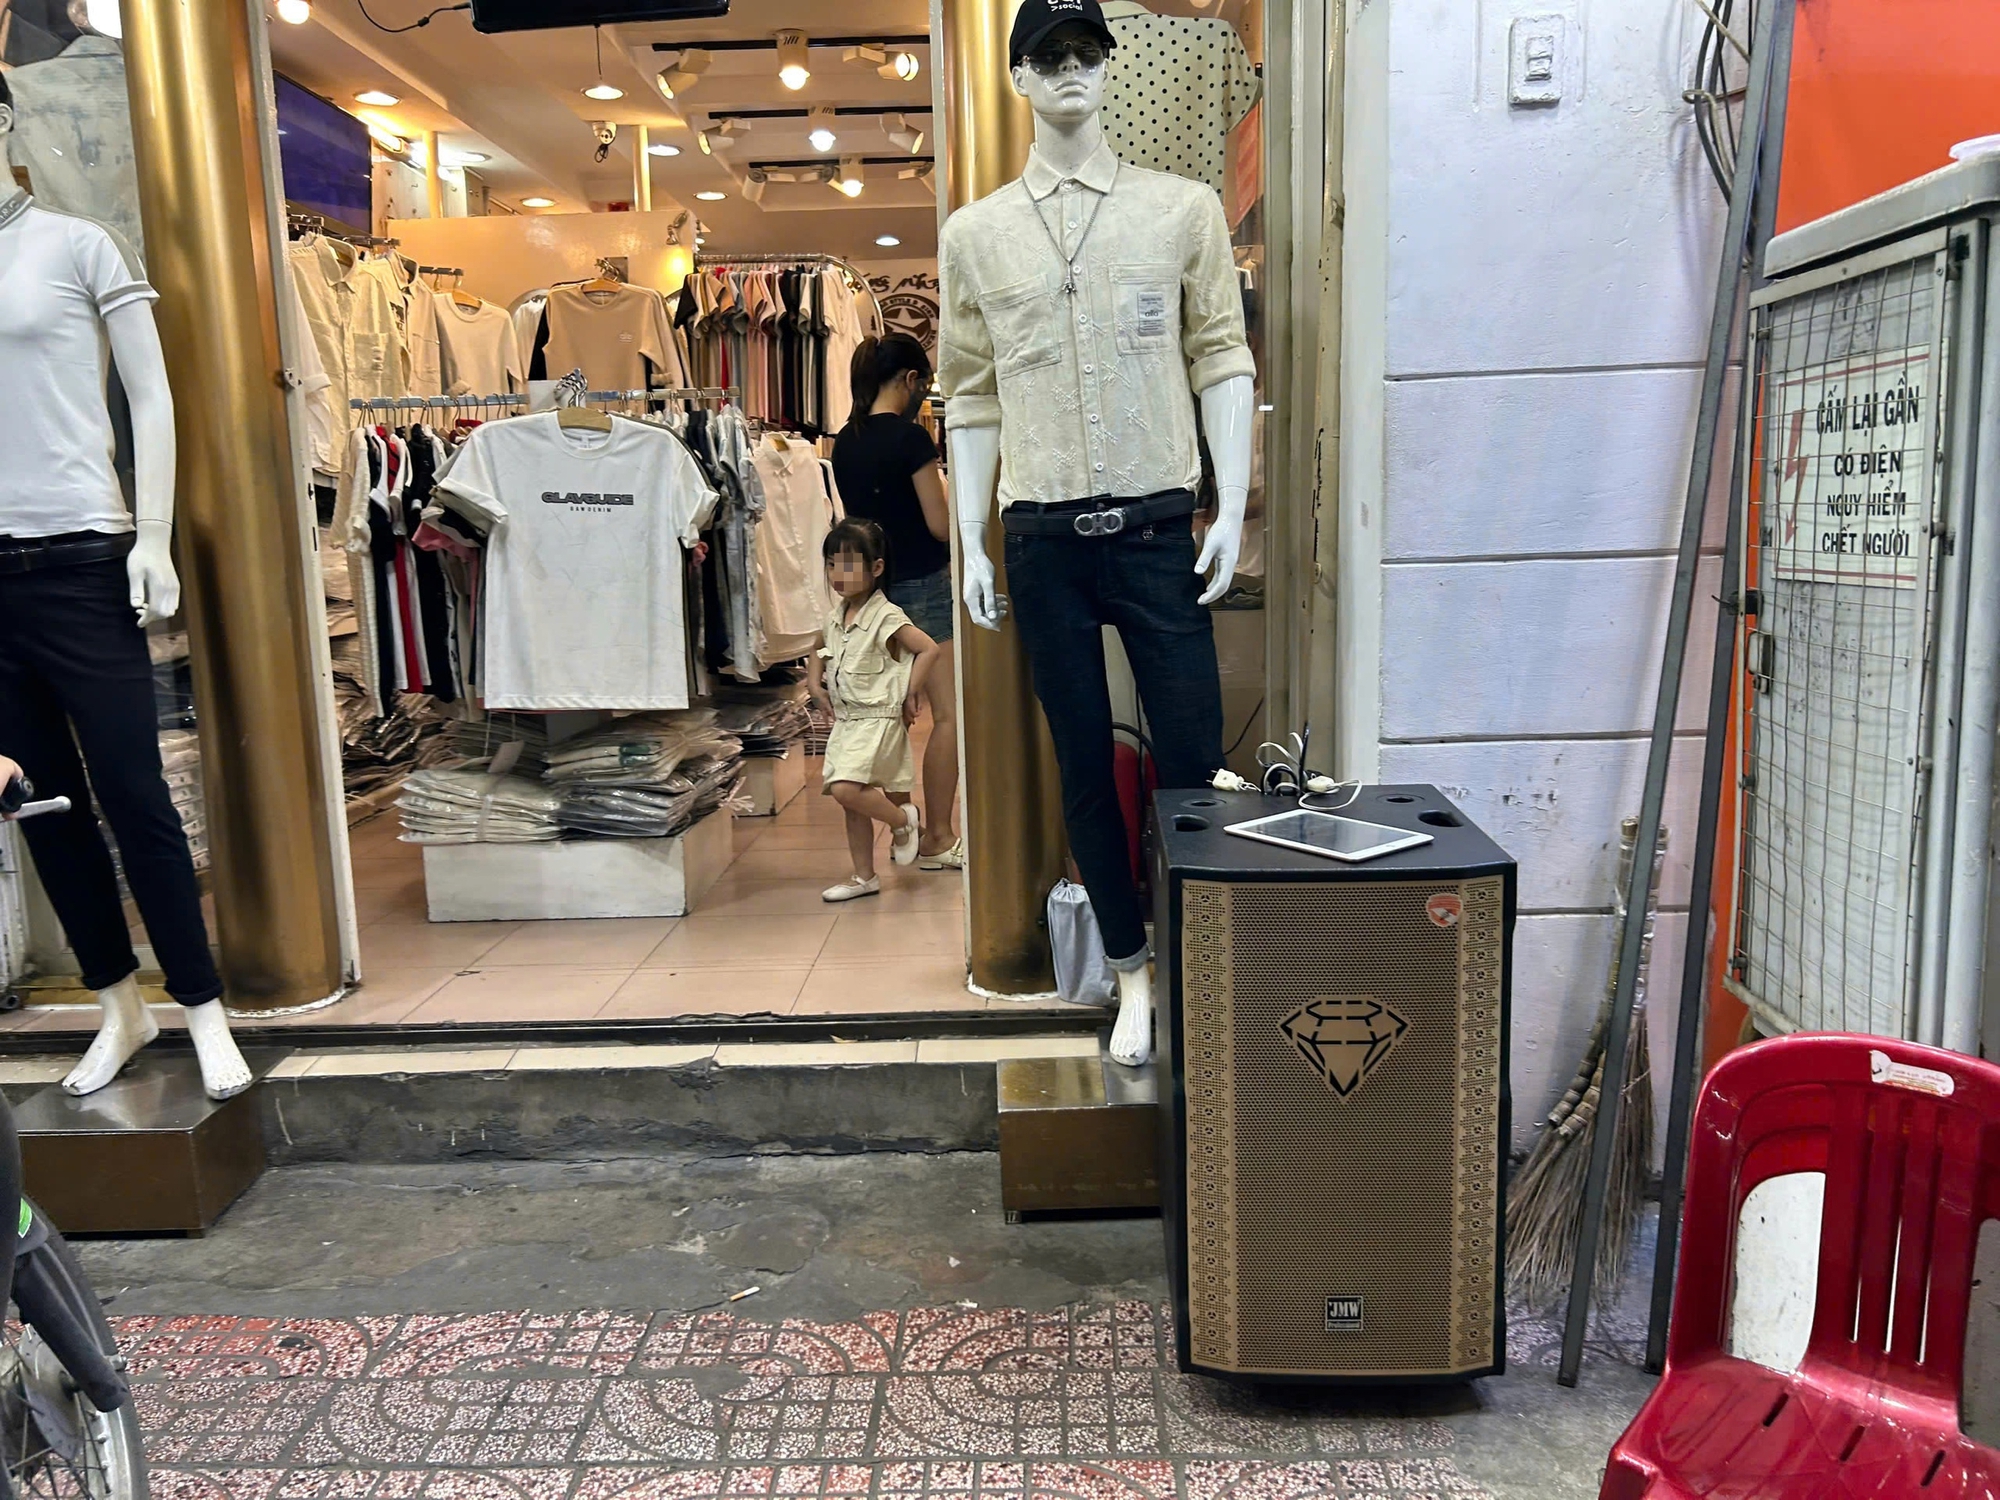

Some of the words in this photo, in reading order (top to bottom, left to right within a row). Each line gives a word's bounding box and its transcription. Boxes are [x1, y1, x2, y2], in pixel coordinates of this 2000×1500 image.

[1816, 384, 1847, 435] CẤM
[1852, 392, 1879, 437] LẠI
[1884, 371, 1920, 427] GẦN
[1834, 447, 1855, 476] CÓ
[1860, 444, 1902, 478] ĐIỆN
[1826, 494, 1862, 517] NGUY
[1867, 479, 1907, 516] HIỂM
[1821, 524, 1858, 554] CHẾT
